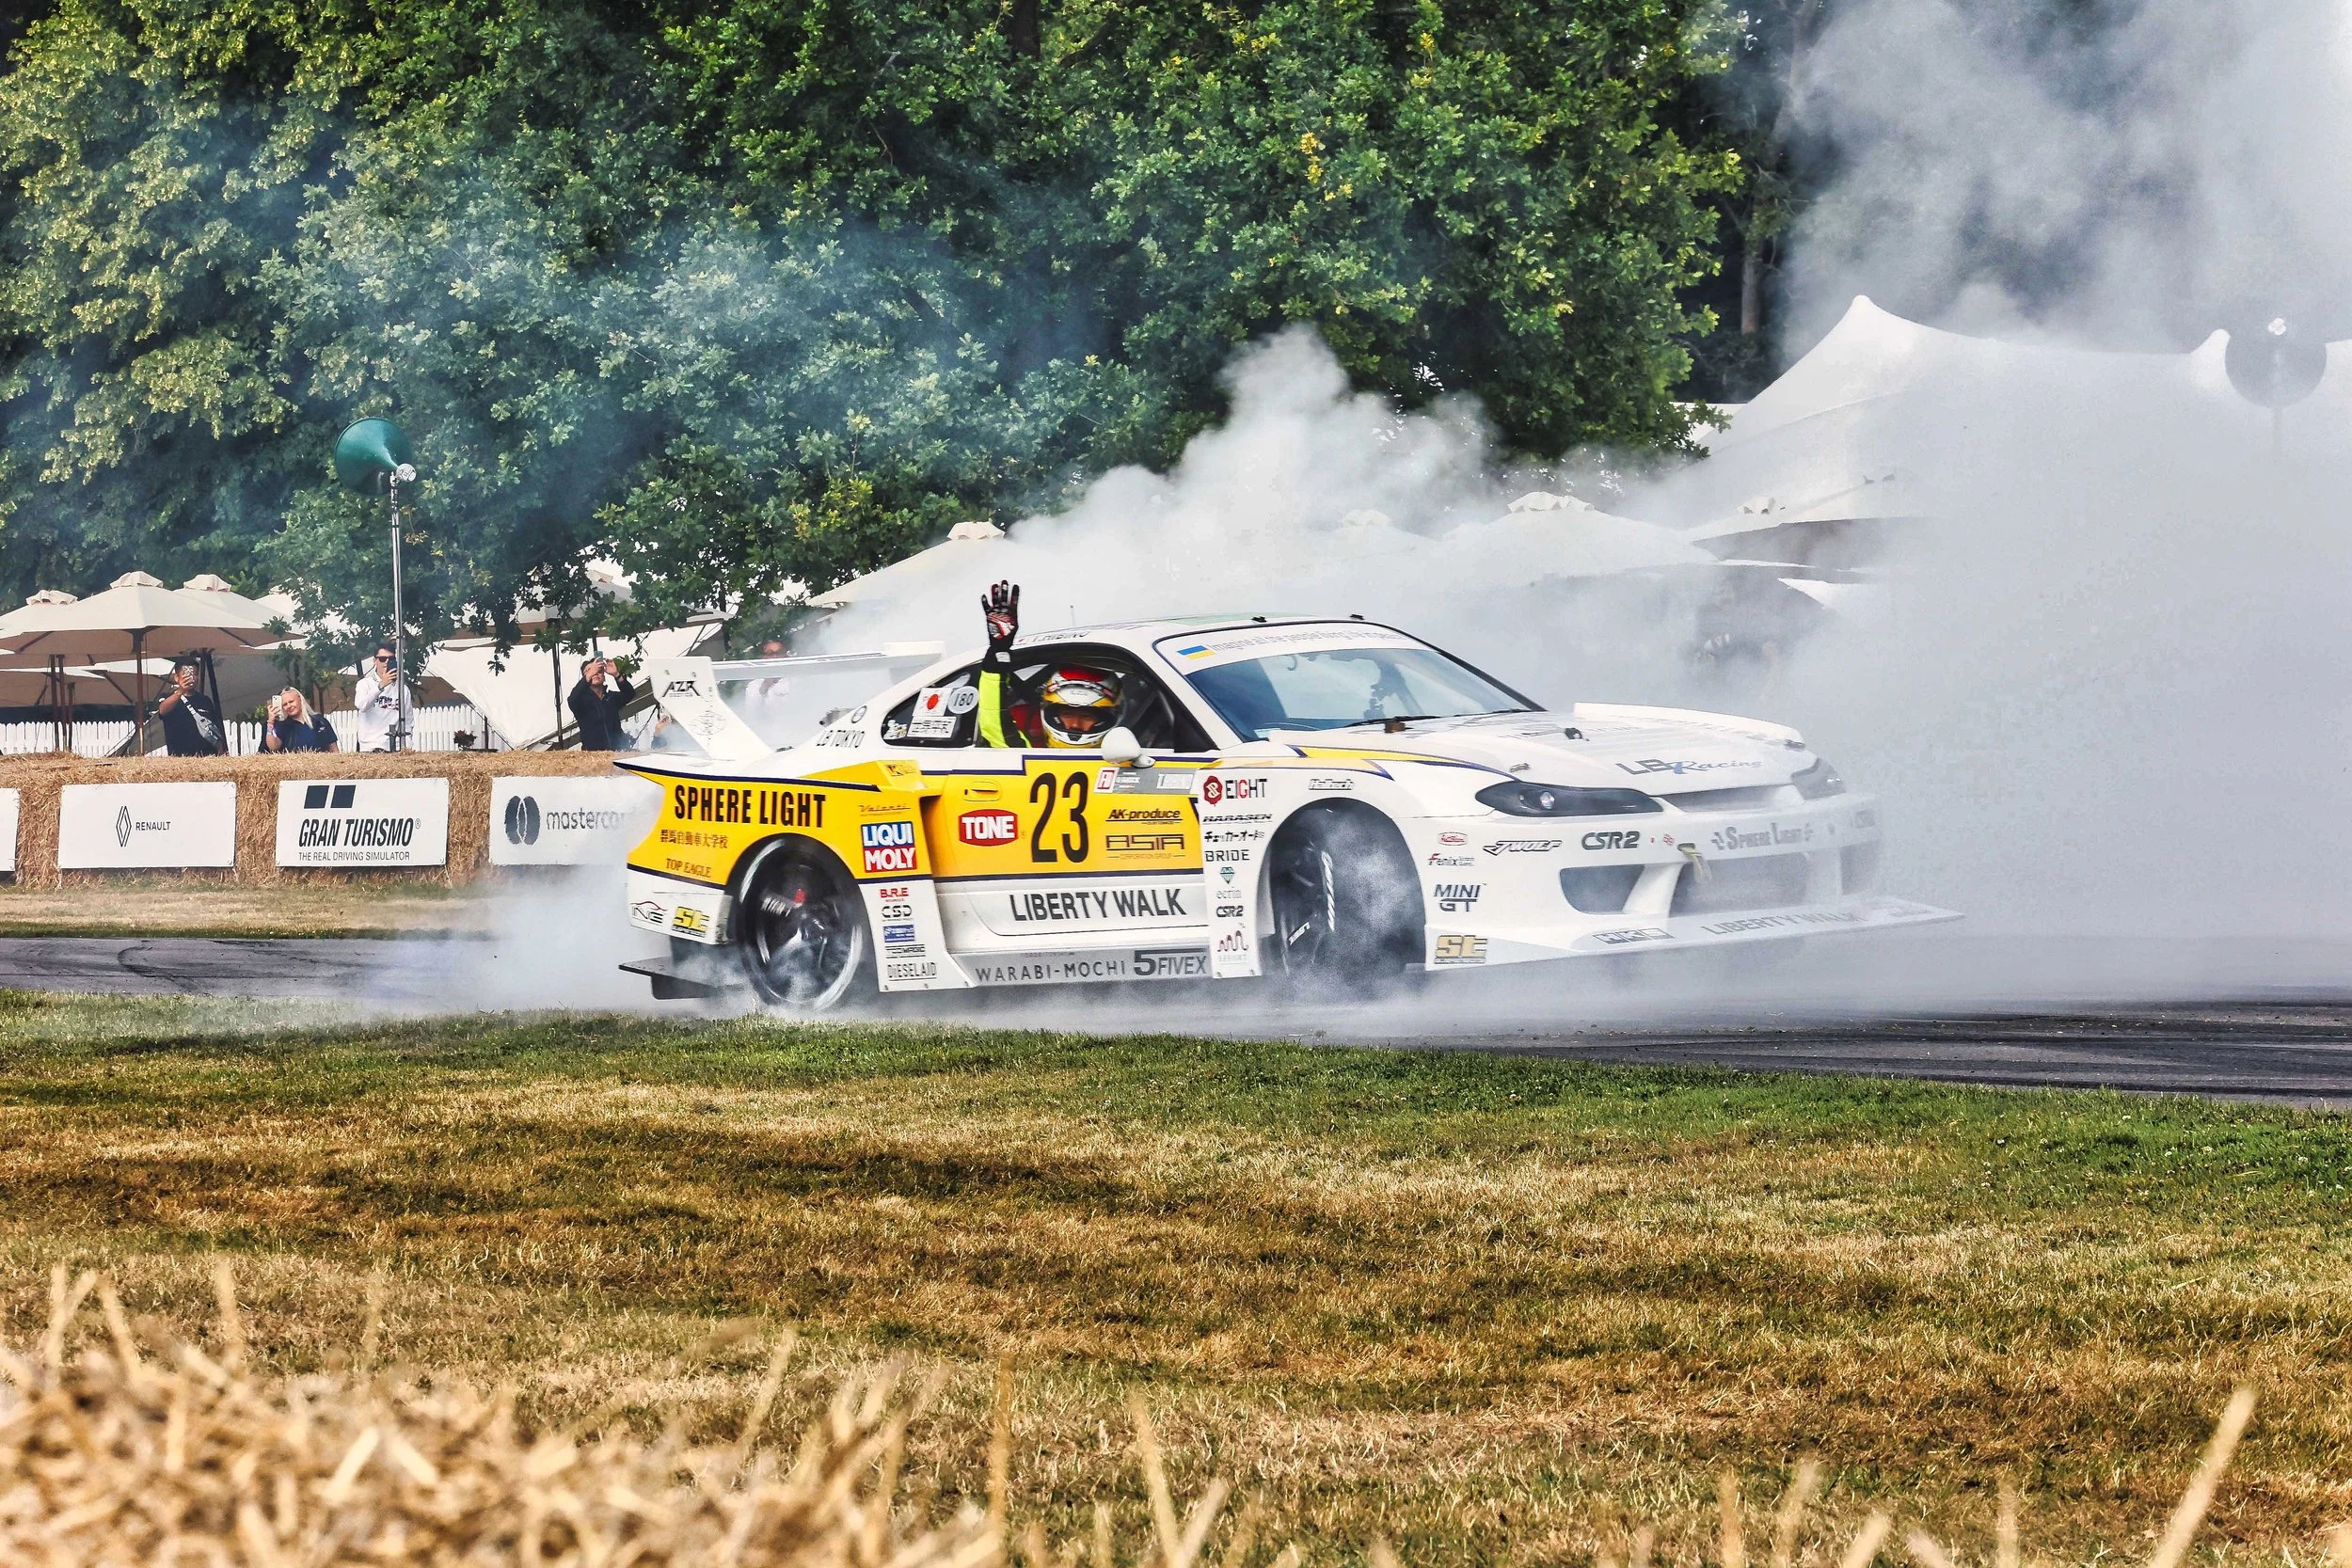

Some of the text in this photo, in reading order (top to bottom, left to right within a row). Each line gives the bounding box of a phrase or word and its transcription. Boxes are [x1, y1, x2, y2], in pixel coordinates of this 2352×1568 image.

[953, 692, 974, 706] 180
[1226, 778, 1267, 800] EIGHT
[675, 784, 826, 829] SPHERE LIGHT
[1108, 808, 1181, 820] AK-produce
[135, 821, 171, 832] RENAULT
[1029, 771, 1089, 863] 23
[299, 819, 340, 847] GRAN
[862, 823, 914, 847] LIQUI
[961, 816, 1015, 840] TONE
[1105, 834, 1184, 851] ASIA
[1581, 831, 1640, 850] CSR2
[299, 851, 410, 861] THE REAL DRIVING SIMULATOR
[865, 847, 916, 871] MOLY
[1204, 849, 1250, 863] BRIDE
[666, 858, 712, 878] TOP EAGLE
[1434, 884, 1481, 897] MINI
[1009, 889, 1186, 921] LIBERTY WALK
[1216, 905, 1244, 918] CSR2
[1439, 898, 1477, 912] GT
[1701, 914, 1800, 935] LIBERTY
